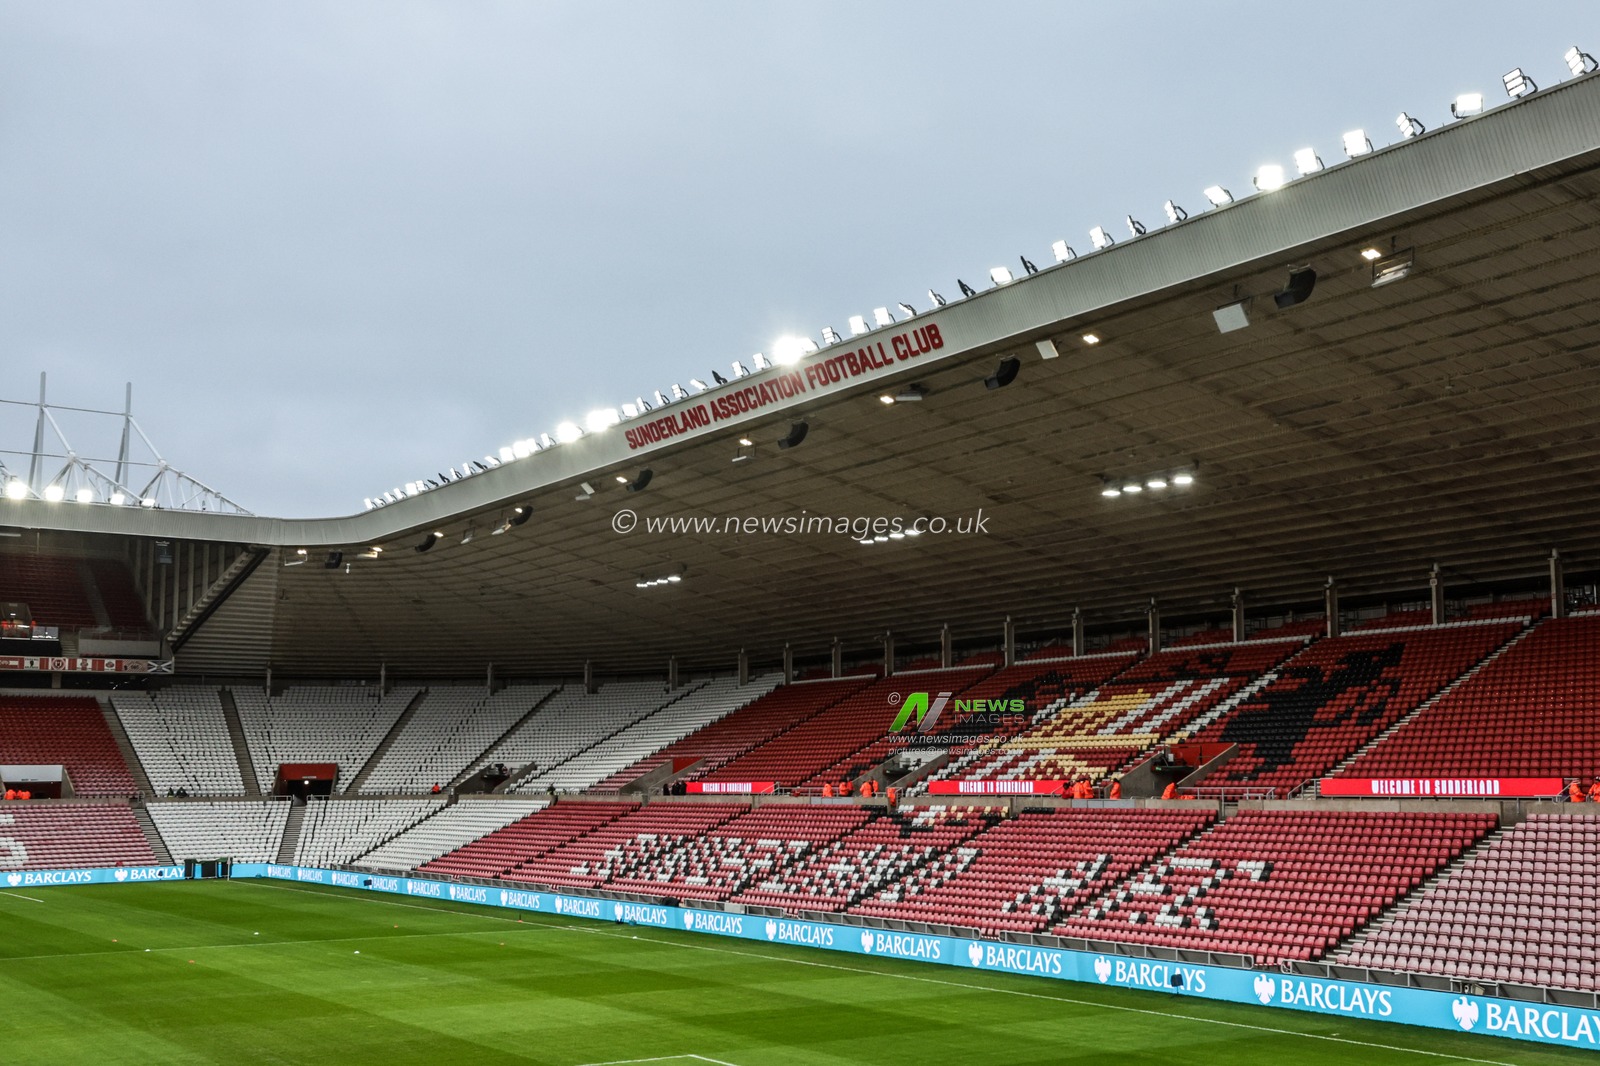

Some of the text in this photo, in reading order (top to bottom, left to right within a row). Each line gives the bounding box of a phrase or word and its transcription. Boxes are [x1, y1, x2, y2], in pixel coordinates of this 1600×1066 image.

[625, 323, 944, 450] SUNDERLAND ASSOCIATION FOOTBALL CLUB
[1371, 780, 1499, 794] WELCOME TO SUNDERLAND
[25, 870, 92, 884] BARCLAYS
[130, 867, 185, 880] BARCLAY
[411, 879, 440, 896] BARCLAYS
[456, 886, 486, 902] BARCLAYS
[508, 891, 540, 908] BARCLAYS
[563, 899, 599, 916] BARCLAYS
[624, 905, 667, 924] BARCLAYS
[695, 913, 743, 934] BARCLAYS
[778, 923, 834, 945] BARCLAYS
[876, 934, 941, 959] BARCLAYS
[986, 946, 1062, 974] BARCLAYS
[1281, 980, 1393, 1017] BARCLAYS
